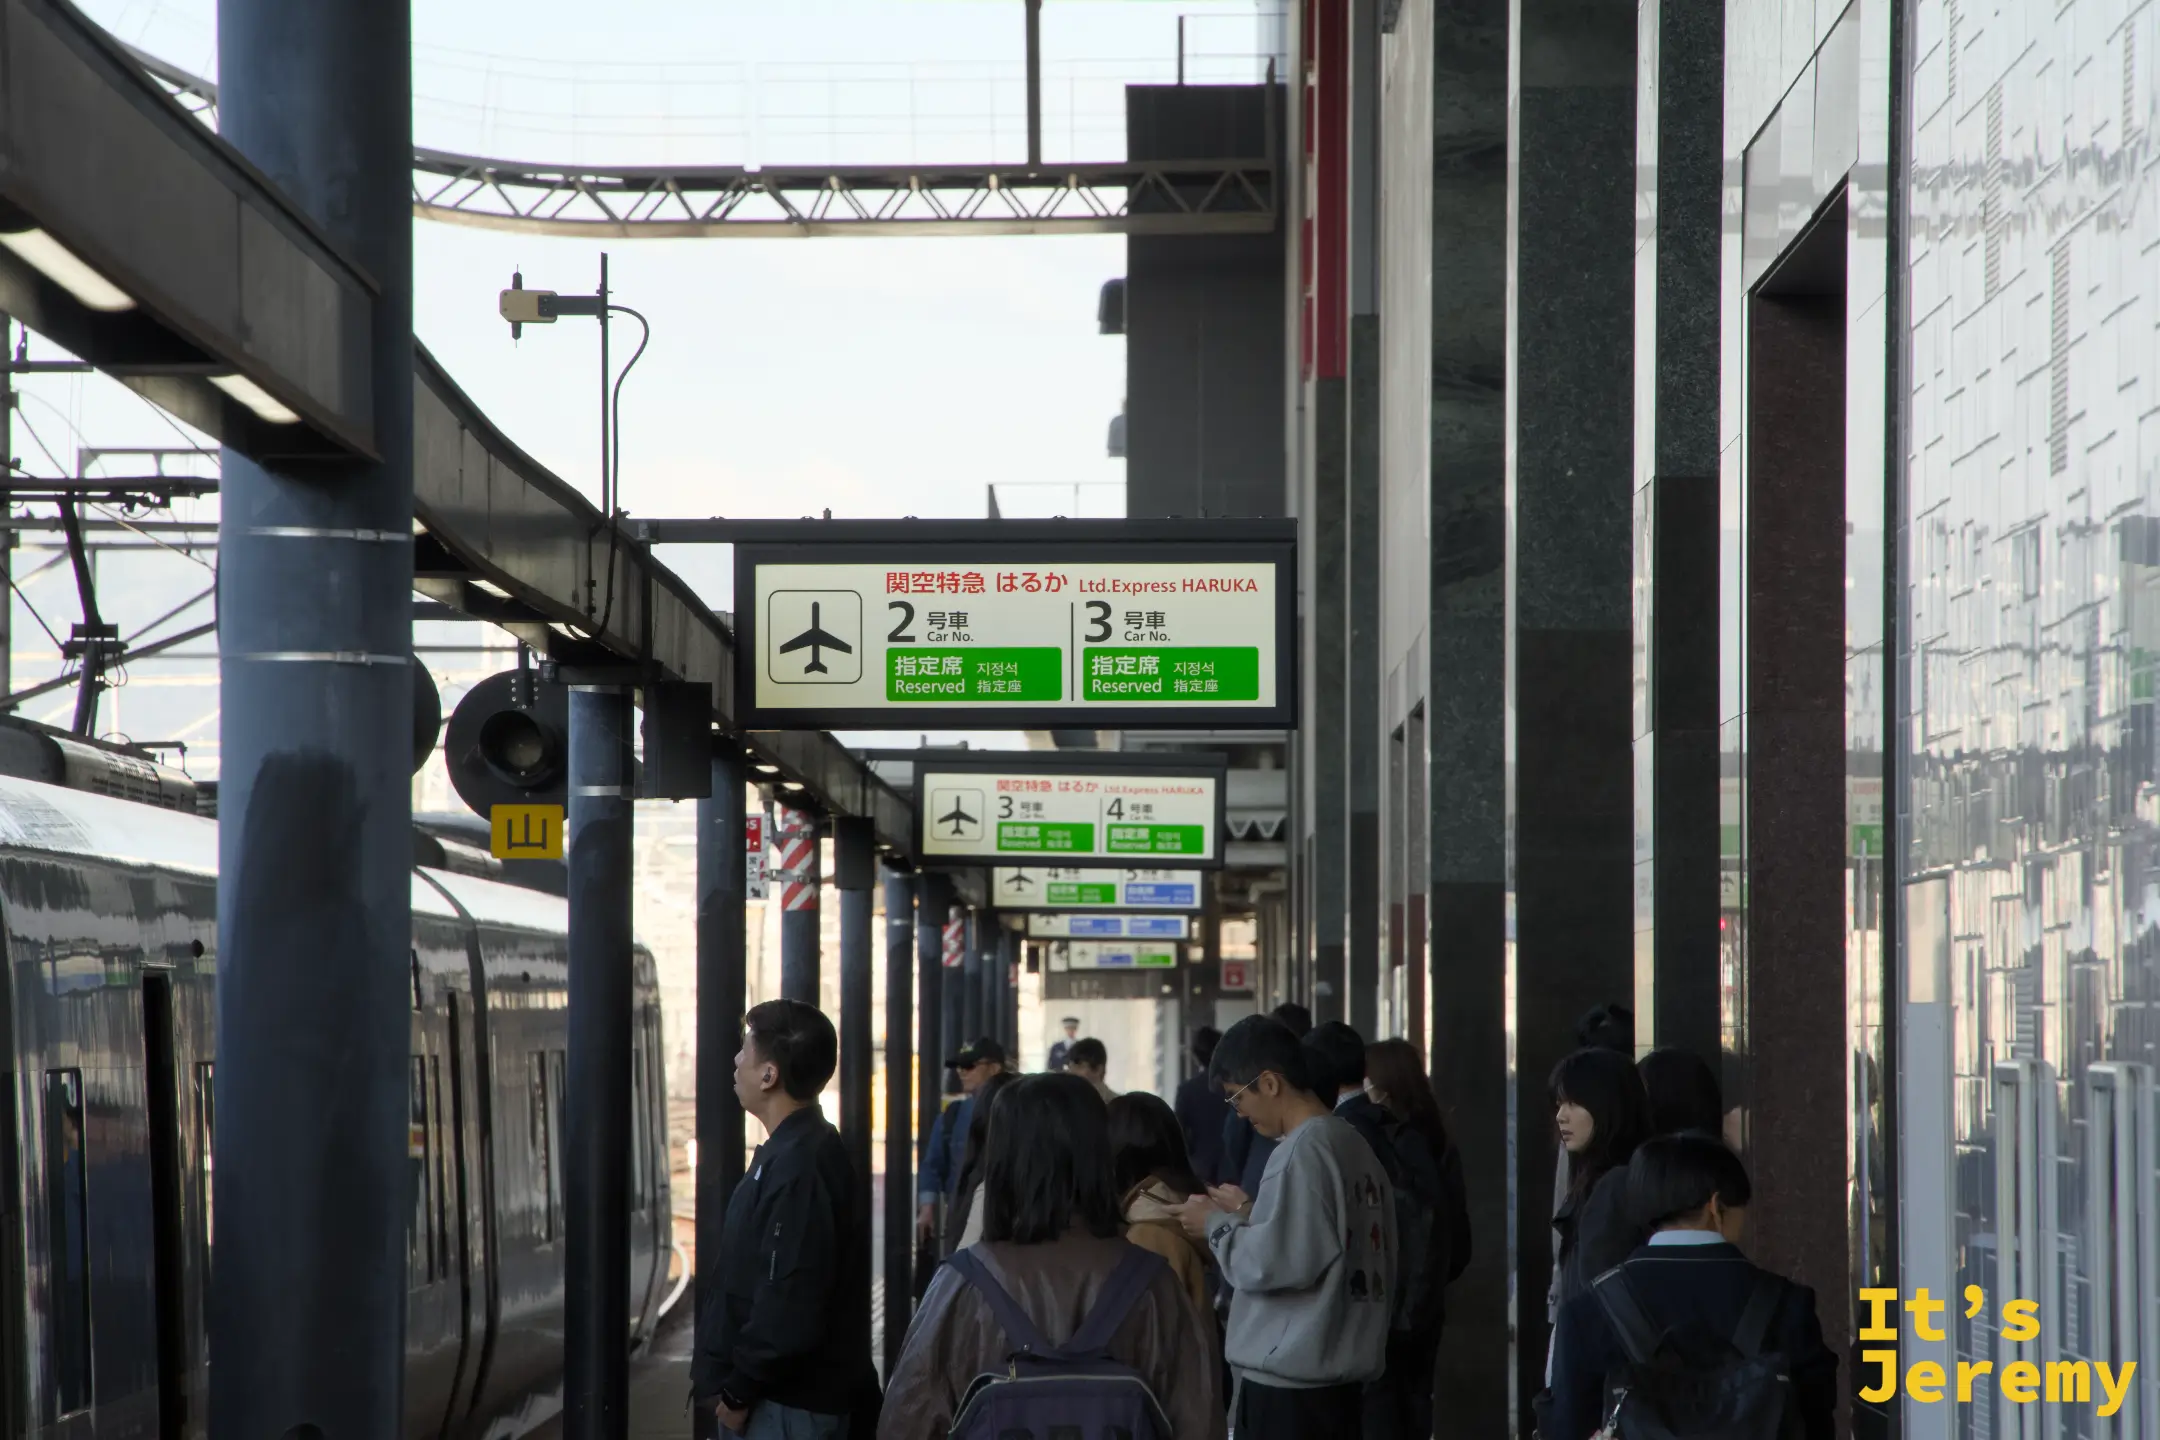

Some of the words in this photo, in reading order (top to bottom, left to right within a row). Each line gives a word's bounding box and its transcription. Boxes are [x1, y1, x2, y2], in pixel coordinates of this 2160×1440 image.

[885, 571, 986, 595] 関空特急
[996, 572, 1069, 593] はるか
[1181, 578, 1258, 592] HARUKA
[887, 601, 916, 642] 2
[927, 610, 969, 630] 号車
[1084, 601, 1113, 642] 3
[1124, 610, 1166, 629] 号車
[926, 630, 949, 642] Car
[952, 630, 974, 642] No.
[1123, 630, 1146, 642] Car
[1149, 630, 1171, 642] No.
[894, 656, 963, 676] 指定席
[976, 662, 1018, 676] 지정석
[1091, 655, 1160, 676] 指定席
[1173, 662, 1215, 676] 지정석
[895, 678, 966, 693] Reserved
[976, 679, 1022, 693] 指定座
[1091, 678, 1162, 693] Reserved
[1173, 679, 1219, 693] 指定座
[997, 796, 1014, 819] 3
[1106, 798, 1125, 820] 4
